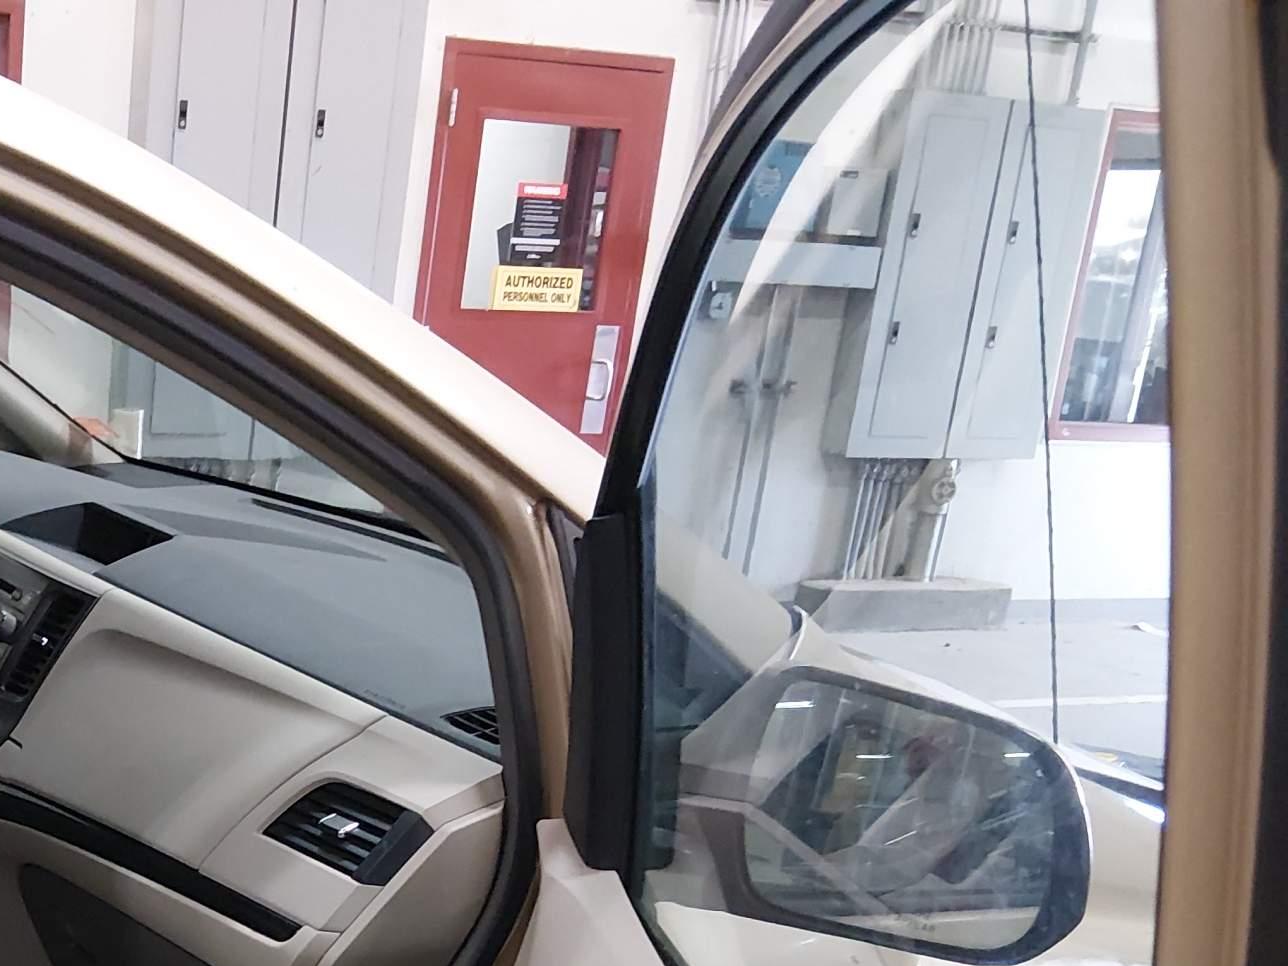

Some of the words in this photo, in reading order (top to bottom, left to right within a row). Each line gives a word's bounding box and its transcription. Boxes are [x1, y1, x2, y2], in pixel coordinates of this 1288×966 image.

[505, 275, 574, 289] AUTHORIZED
[502, 291, 548, 302] PERSONNEL
[550, 292, 572, 304] ONLY
